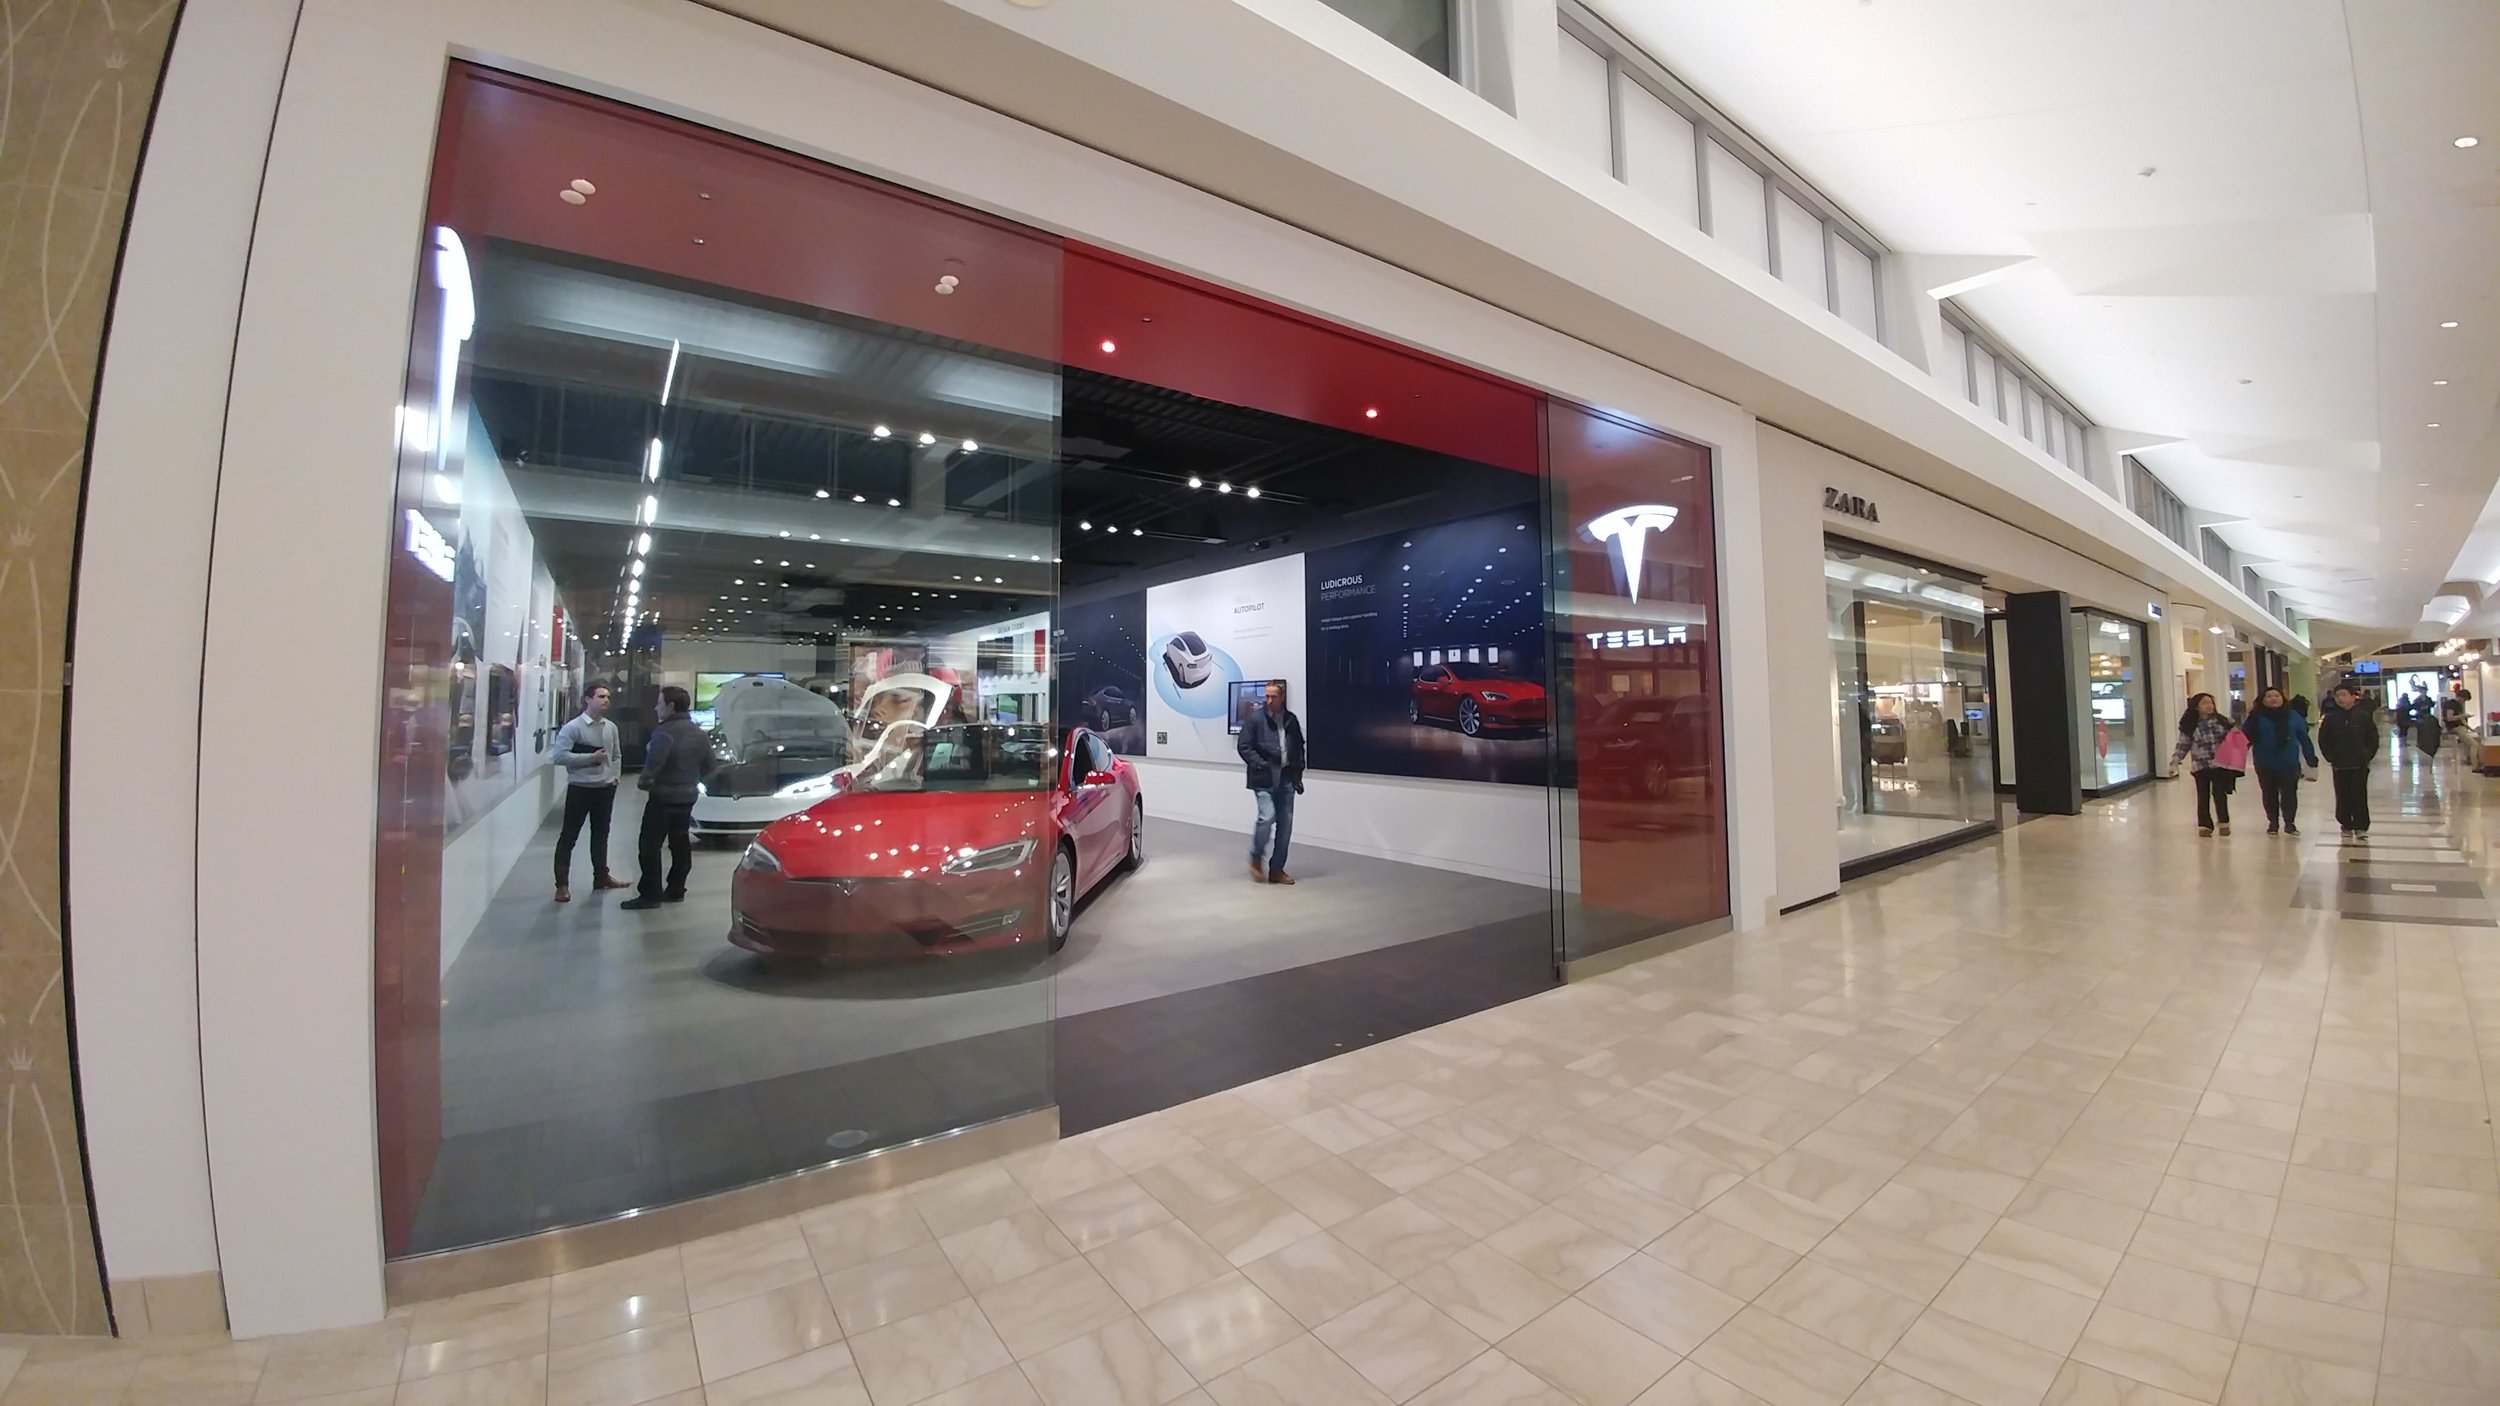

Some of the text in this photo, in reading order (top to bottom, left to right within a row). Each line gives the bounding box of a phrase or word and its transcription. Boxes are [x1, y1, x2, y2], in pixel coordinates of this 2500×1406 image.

[1824, 486, 1881, 523] ZARA
[1320, 574, 1363, 590] LUDICROUS
[1320, 584, 1376, 601] PERFORMANCE
[1233, 602, 1265, 614] AUTOPILOT
[1585, 625, 1687, 650] TESLA
